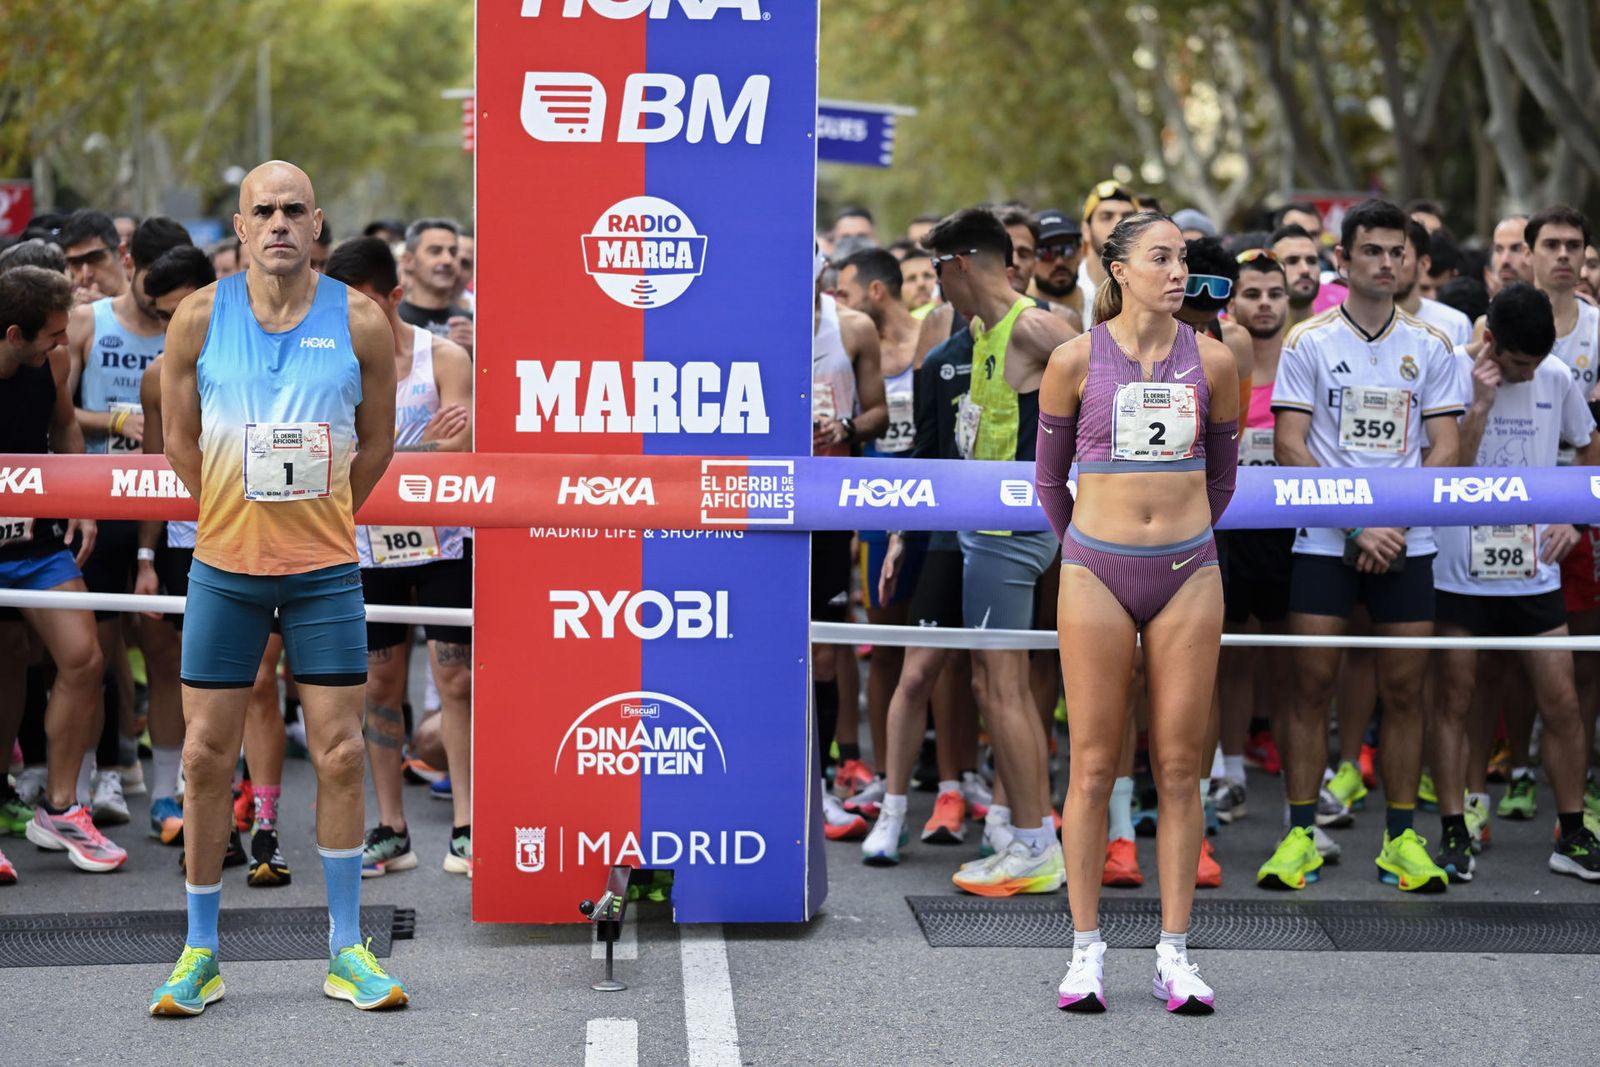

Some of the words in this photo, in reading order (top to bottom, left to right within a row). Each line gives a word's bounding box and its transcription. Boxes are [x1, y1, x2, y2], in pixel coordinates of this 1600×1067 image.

[617, 73, 770, 144] BM
[608, 214, 682, 232] RADIO
[598, 240, 694, 269] MARCA
[300, 336, 336, 349] HOKA
[101, 350, 164, 370] ner
[516, 360, 770, 433] MARCA
[1149, 421, 1166, 446] 2
[1352, 419, 1396, 440] 359
[283, 462, 294, 486] 1
[701, 475, 721, 491] EL
[725, 475, 778, 492] DERBI
[781, 476, 794, 485] DE
[435, 475, 496, 503] BM
[557, 476, 656, 505] HOKA
[701, 492, 795, 509] AFICIONES
[838, 479, 937, 507] HOKA
[1274, 478, 1374, 506] MARCA
[1433, 476, 1530, 503] HOKA
[383, 531, 422, 551] 180
[529, 527, 599, 539] MADRID
[605, 527, 637, 539] LIFE
[643, 528, 655, 539] &
[660, 528, 745, 540] SHOPPING
[1484, 548, 1524, 567] 398
[623, 706, 657, 715] Pascual
[576, 719, 707, 751] DINAMIC
[577, 752, 703, 775] PROTEIN
[577, 831, 767, 866] MADRID
